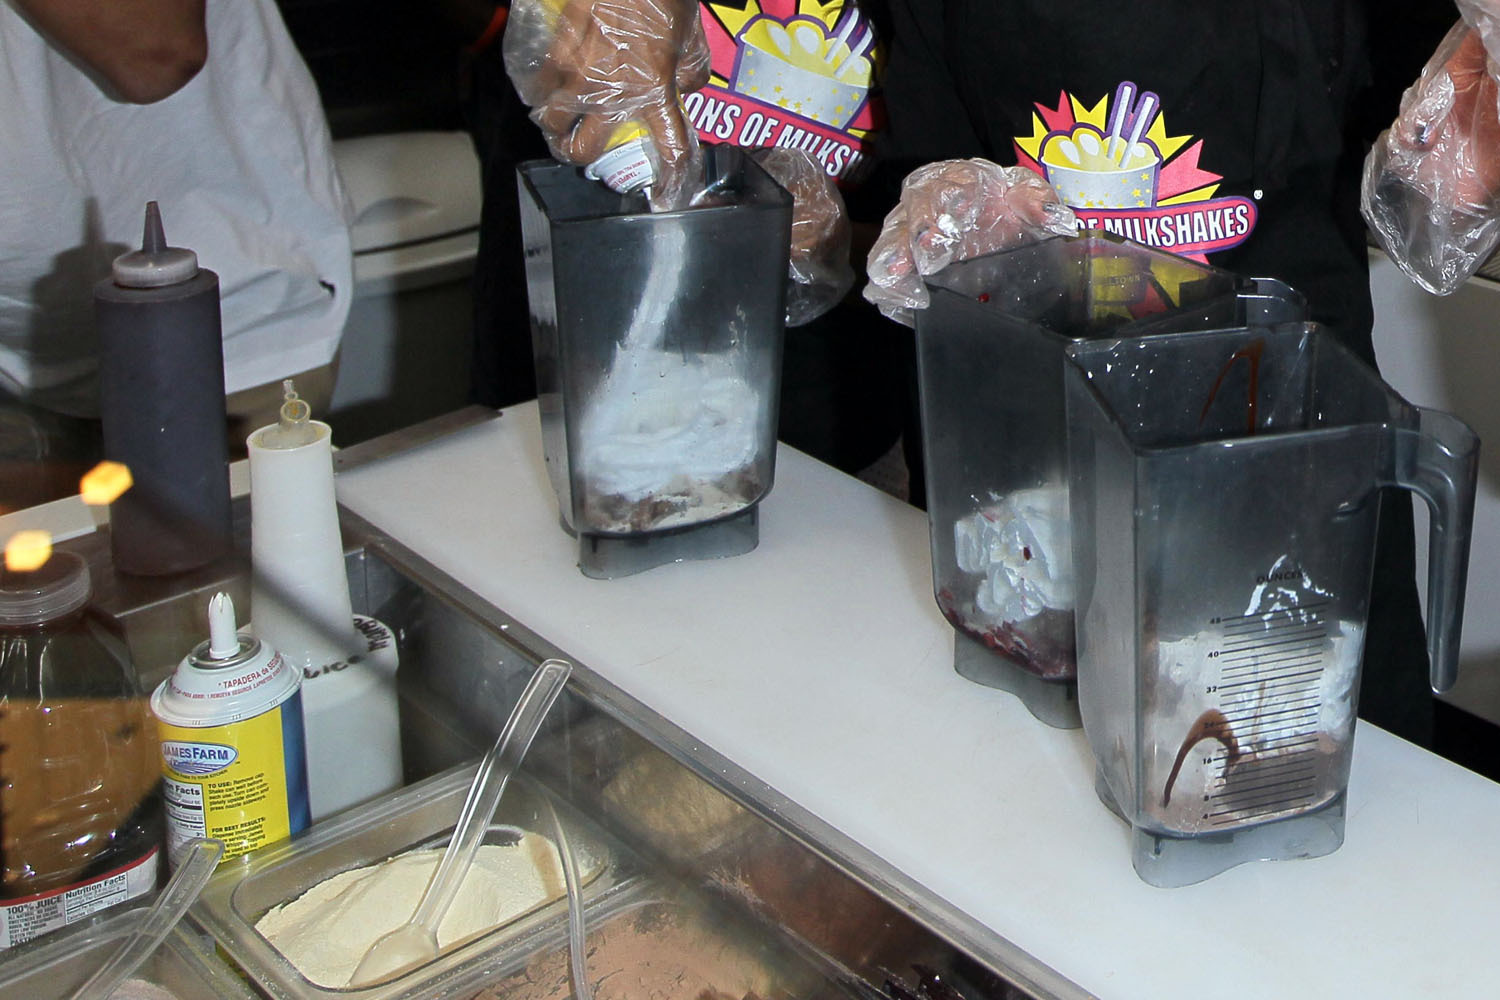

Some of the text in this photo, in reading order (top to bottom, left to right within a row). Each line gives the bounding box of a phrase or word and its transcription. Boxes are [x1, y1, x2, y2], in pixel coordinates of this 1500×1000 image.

[738, 112, 780, 148] OF
[1104, 204, 1250, 247] MILKSHAKES
[223, 671, 261, 688] TAPADERA
[1206, 685, 1217, 693] 32
[1203, 757, 1212, 765] 16
[175, 784, 201, 796] Facts
[65, 883, 102, 899] Nutrition
[103, 874, 126, 887] Facts
[7, 902, 35, 915] 100%
[35, 894, 62, 909] JUICE
